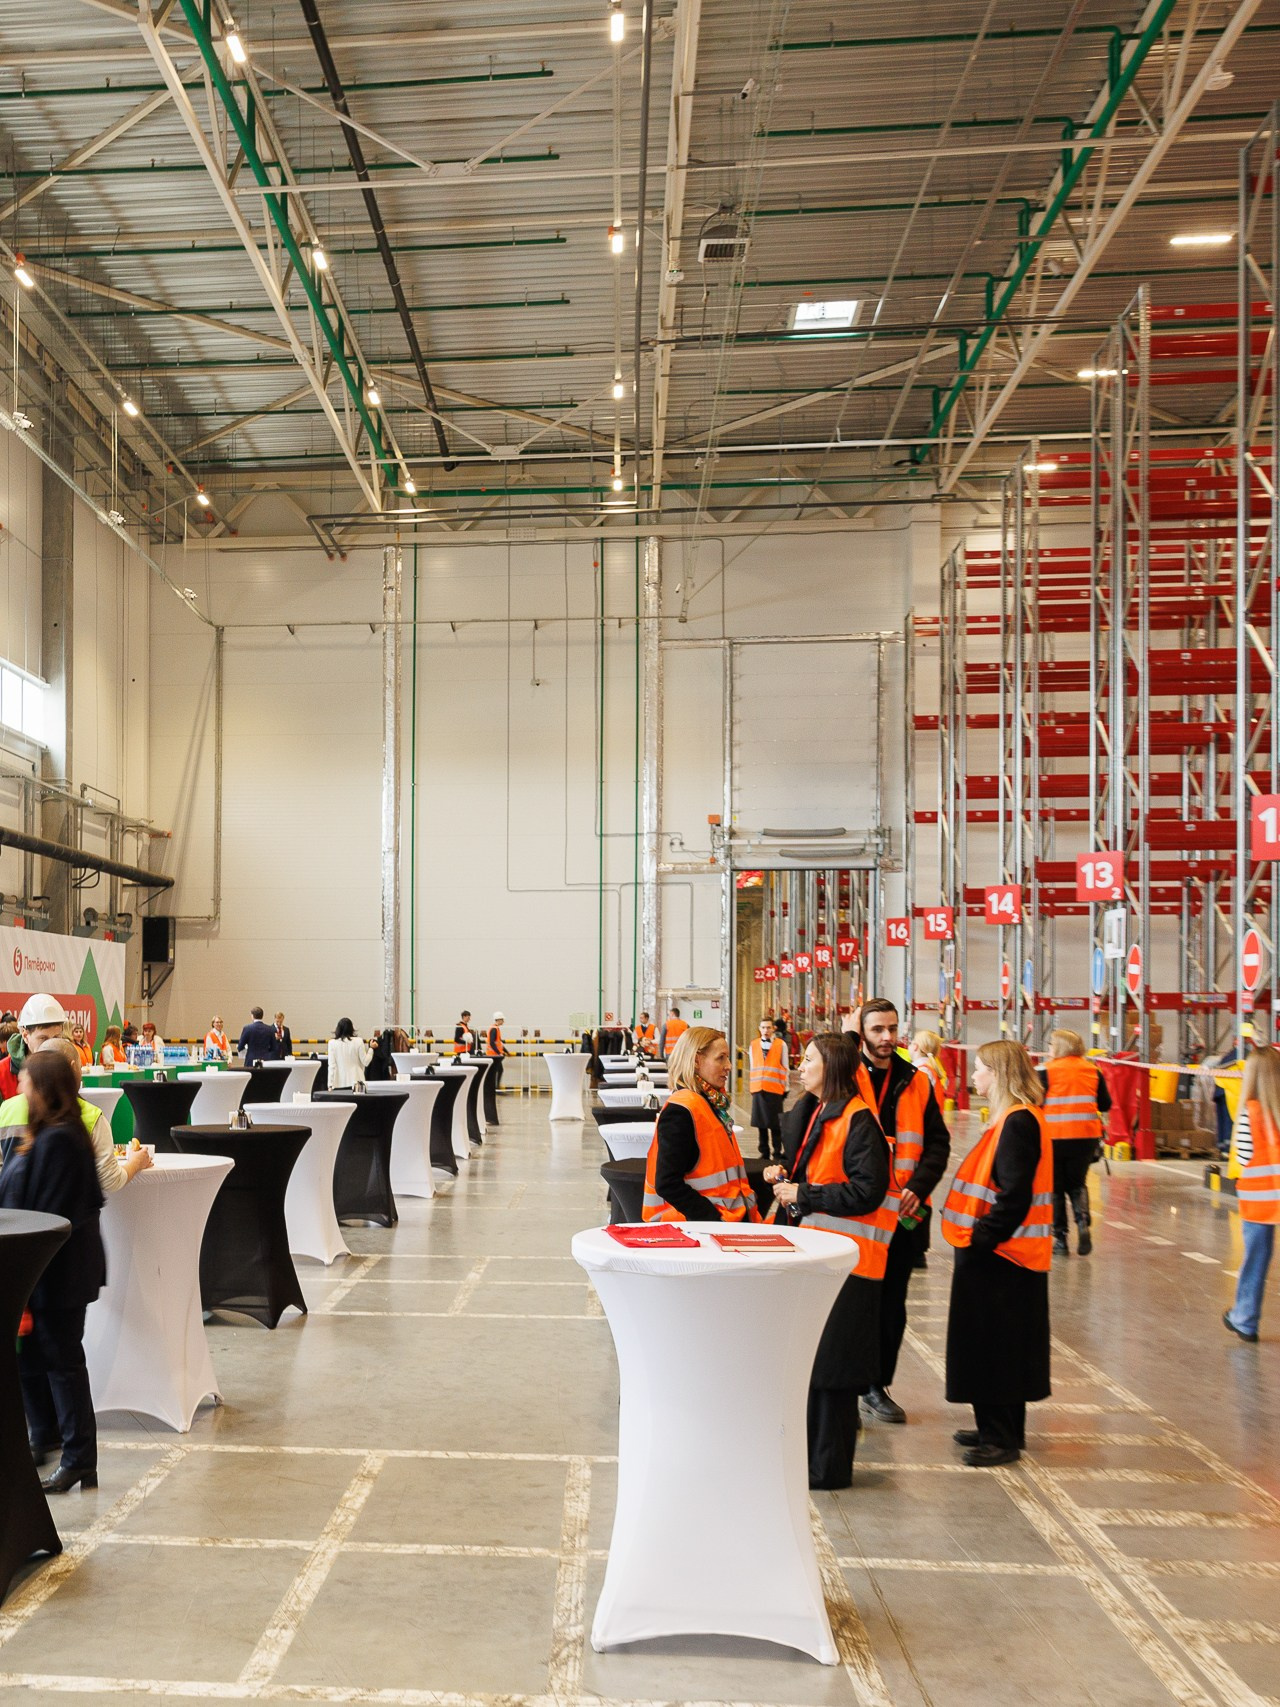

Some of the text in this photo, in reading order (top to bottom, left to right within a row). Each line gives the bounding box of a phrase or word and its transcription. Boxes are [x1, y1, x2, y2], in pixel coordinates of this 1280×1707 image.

[1257, 807, 1280, 843] 1
[1081, 861, 1122, 899] 13 2
[987, 892, 1019, 923] 14 2
[888, 922, 908, 940] 16
[926, 913, 952, 939] 15 2
[816, 949, 830, 962] 18
[839, 942, 855, 957] 17
[24, 956, 56, 975] Пятёрочка
[781, 963, 795, 974] 20
[796, 956, 810, 968] 19
[754, 970, 765, 979] 22
[765, 967, 776, 977] 21
